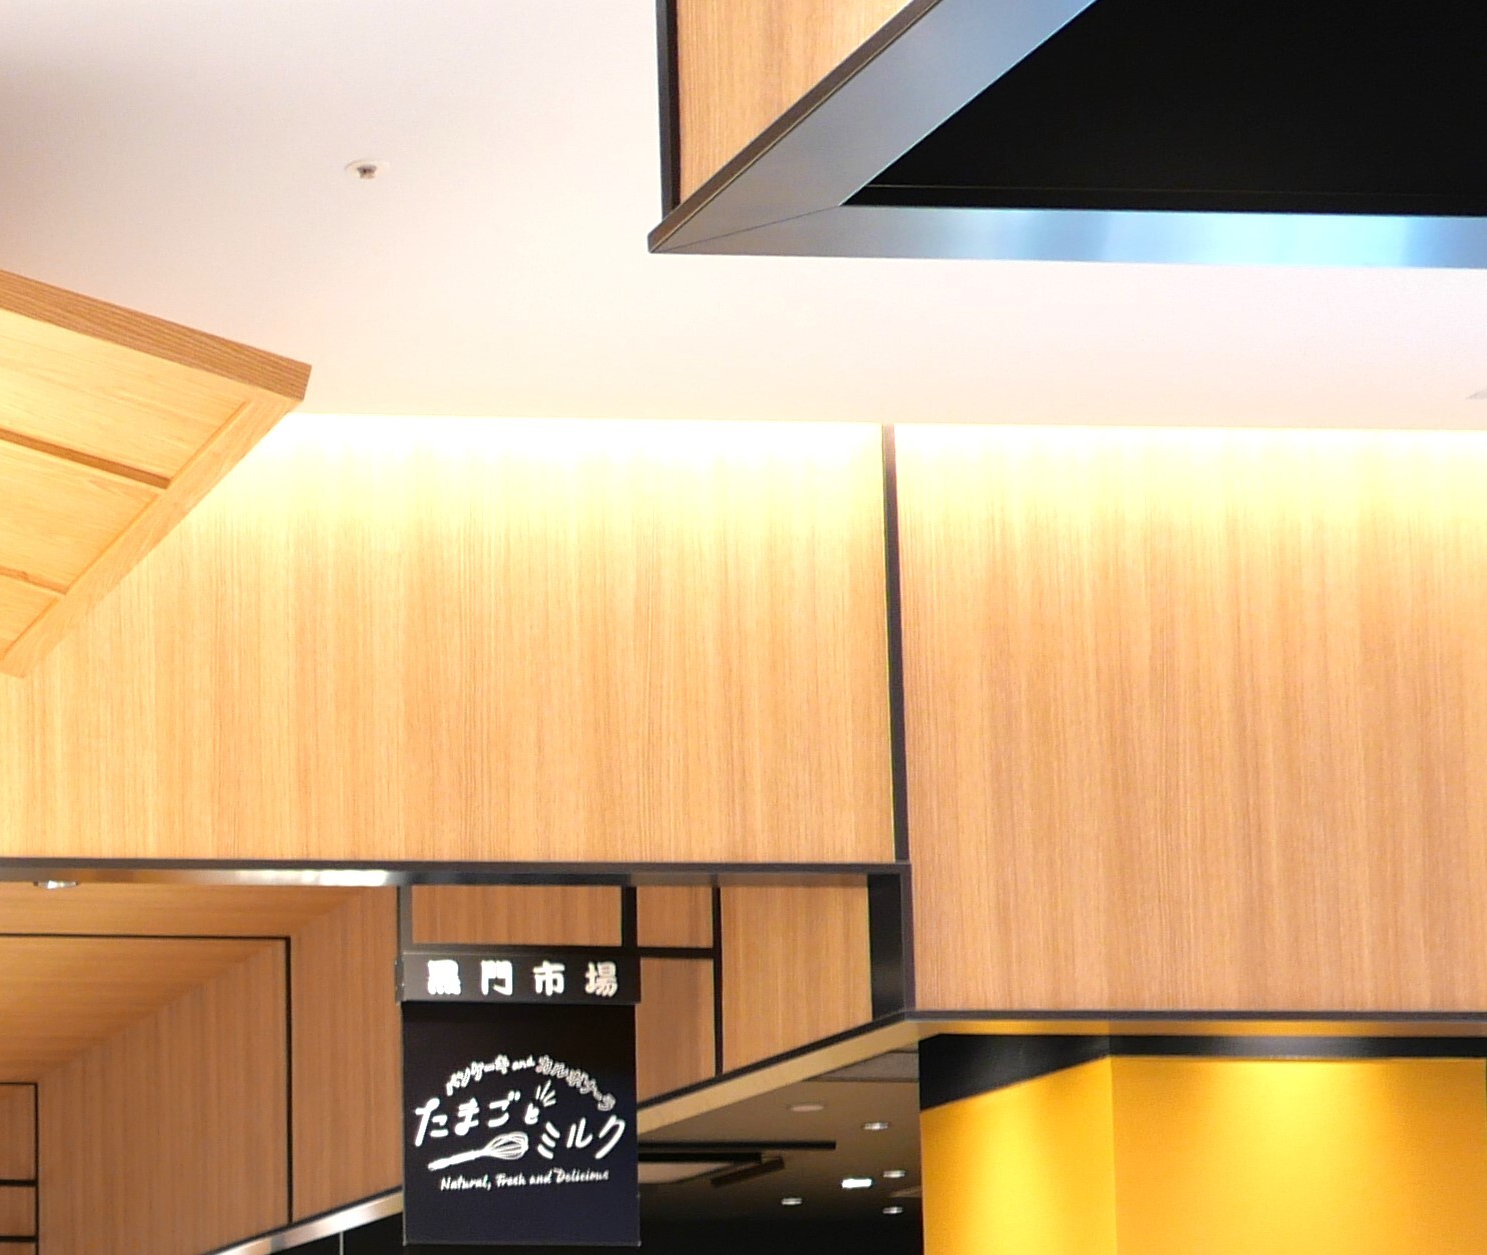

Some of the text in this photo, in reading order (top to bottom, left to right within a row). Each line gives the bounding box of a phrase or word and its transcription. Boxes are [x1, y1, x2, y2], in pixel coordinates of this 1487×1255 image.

[427, 959, 619, 998] 黒門市場
[529, 1168, 553, 1185] and
